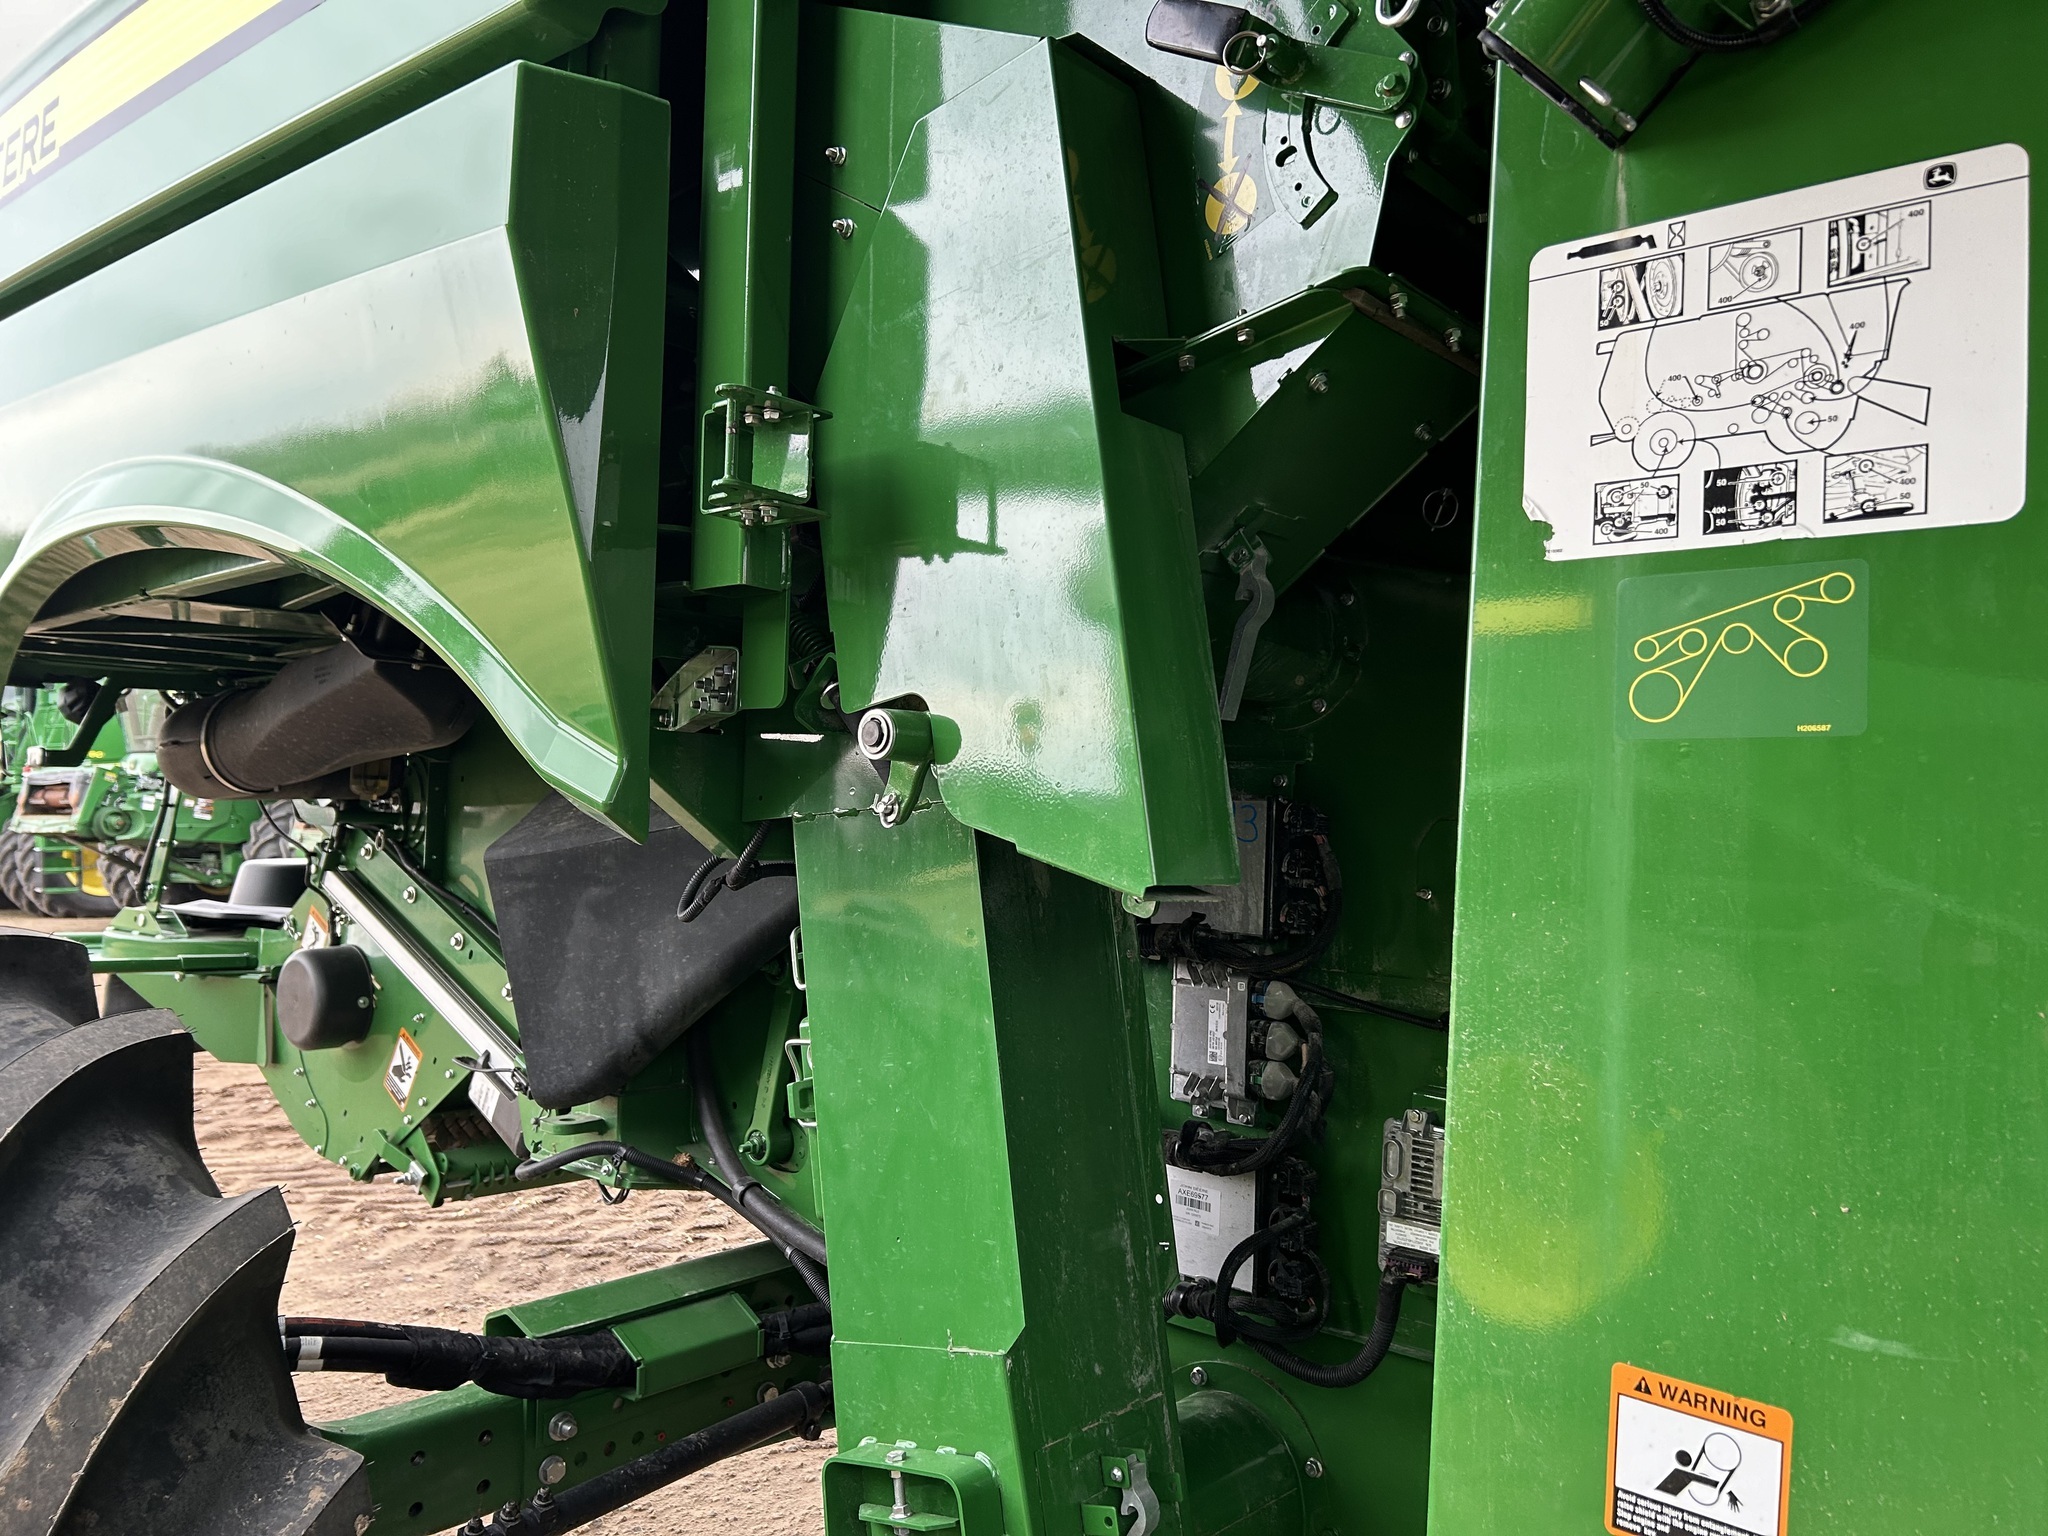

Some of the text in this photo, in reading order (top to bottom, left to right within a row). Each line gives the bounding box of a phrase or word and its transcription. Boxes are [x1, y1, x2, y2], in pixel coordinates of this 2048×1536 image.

[1908, 208, 1924, 218] 400
[1717, 295, 1733, 305] 400
[1849, 321, 1865, 330] 400
[1667, 374, 1682, 383] 400
[1827, 415, 1838, 423] 50
[1715, 479, 1727, 487] 50
[1899, 477, 1916, 486] 400
[1899, 492, 1911, 500] 50
[1711, 506, 1727, 515] 400
[1715, 518, 1726, 526] 50
[1654, 527, 1669, 536] 400
[1658, 1381, 1767, 1429] WARNING
[1617, 1489, 1636, 1504] Avoid
[1636, 1497, 1661, 1513] serious
[1662, 1505, 1682, 1520] injury
[1683, 1512, 1700, 1525] from
[1616, 1518, 1641, 1533] remove
[1656, 1522, 1670, 1534] and
